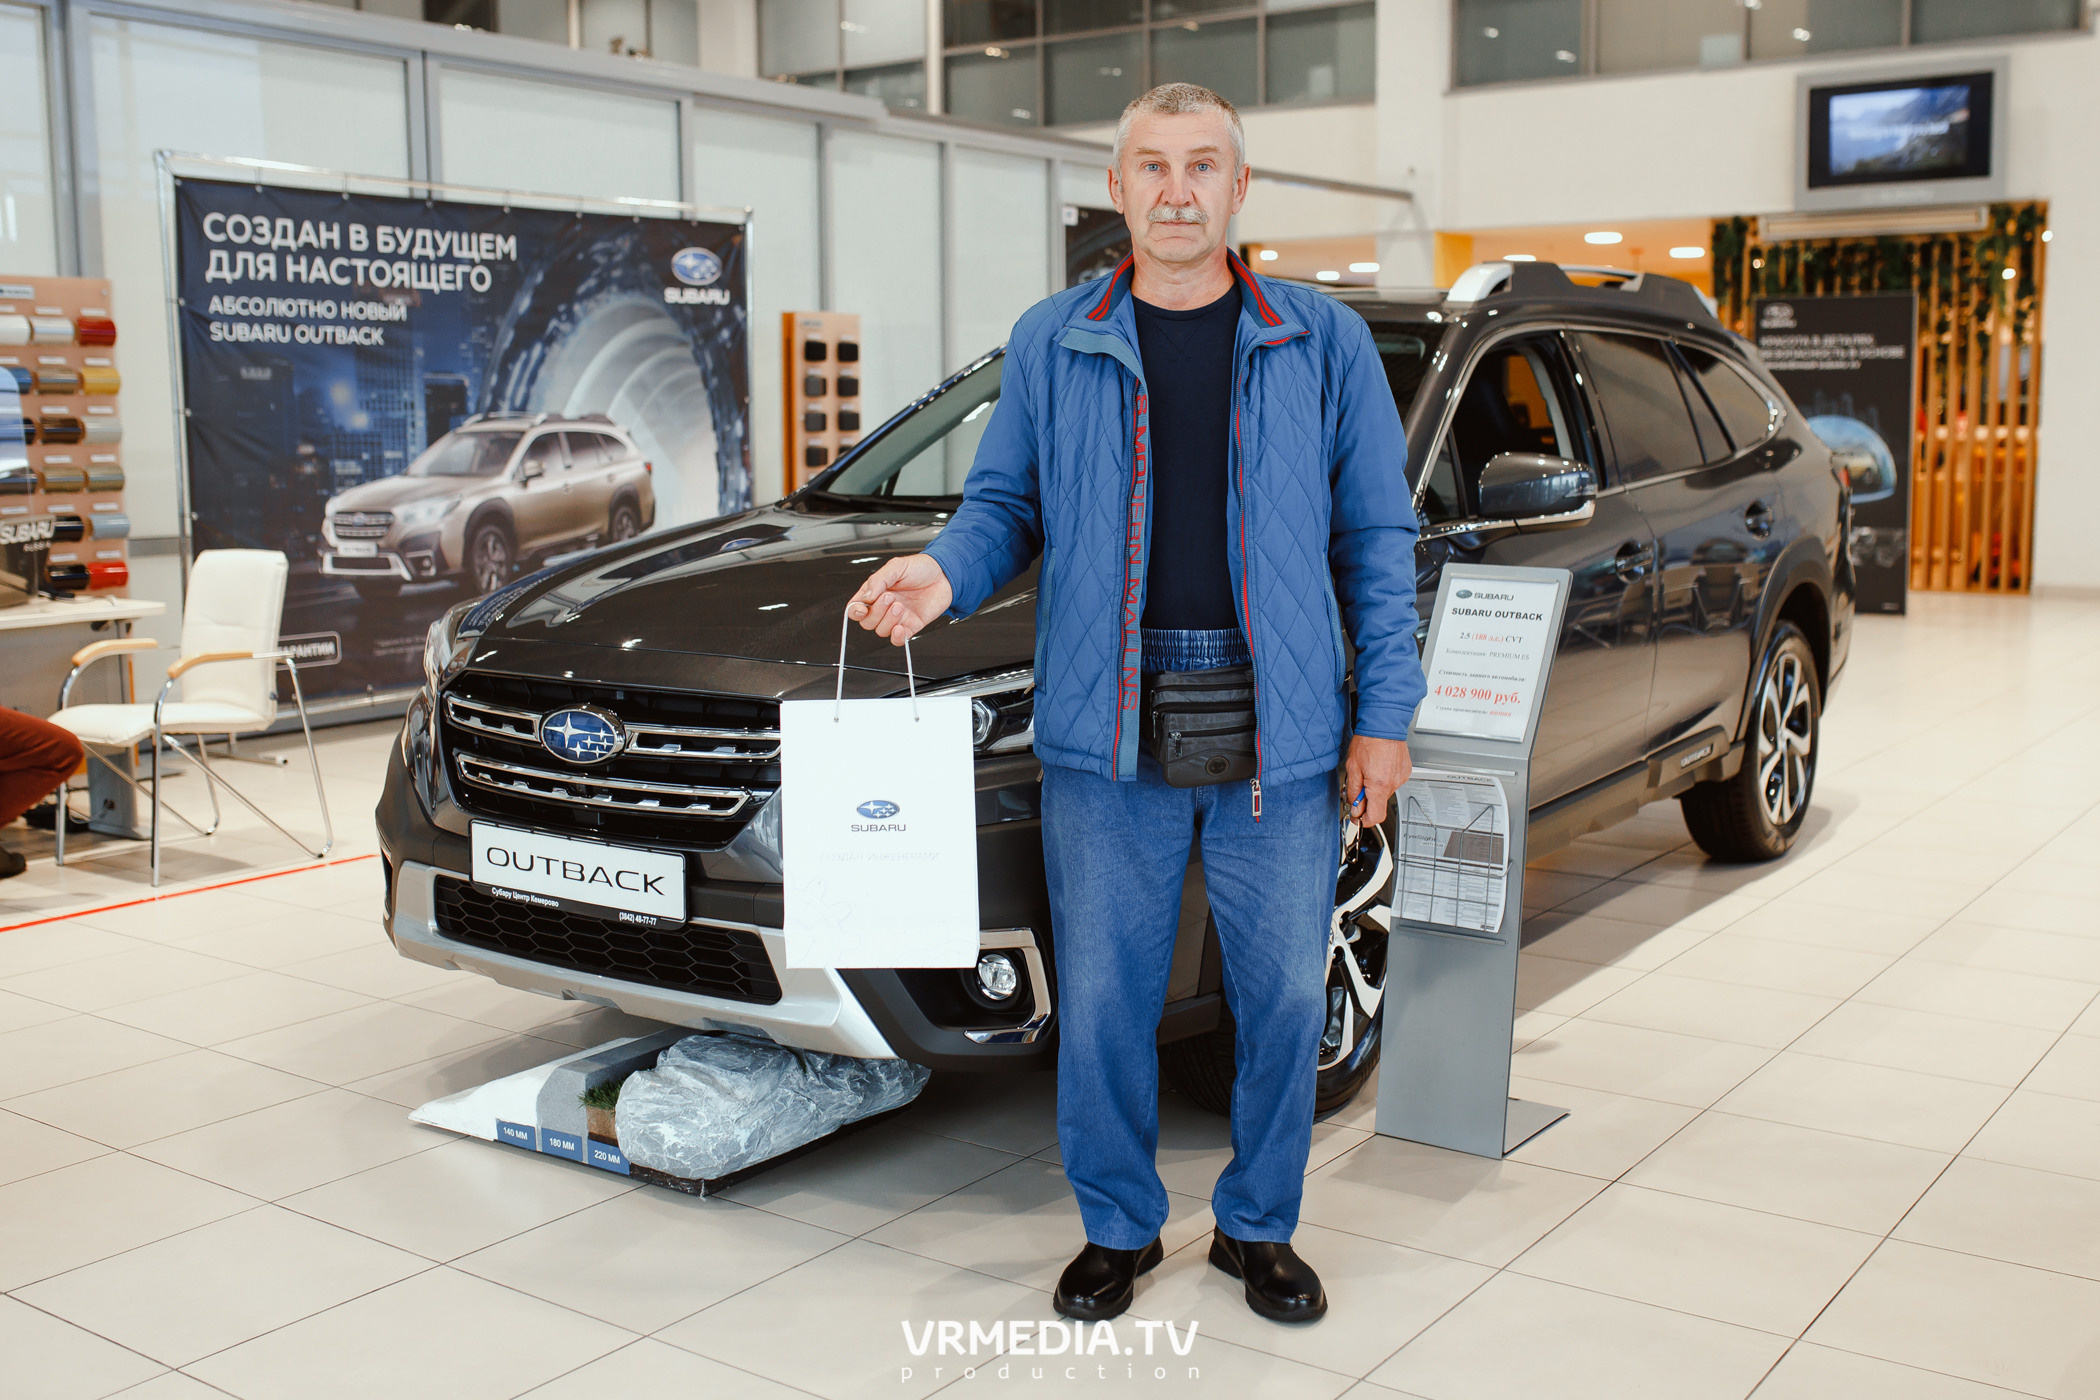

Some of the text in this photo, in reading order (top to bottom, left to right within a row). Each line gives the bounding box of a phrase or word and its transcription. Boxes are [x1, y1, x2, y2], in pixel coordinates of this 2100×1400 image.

[203, 212, 518, 264] СОЗДАН В БУДУЩЕМ
[205, 249, 493, 295] ДЛЯ НАСТОЯЩЕГО
[664, 287, 731, 305] SUBARU
[208, 295, 408, 322] АБСОЛЮТНО НОВЫЙ
[209, 321, 385, 346] SUBARU OUTBACK
[1474, 592, 1515, 601] SUBARU
[1451, 607, 1543, 621] SUBARU OUTBACK
[1460, 632, 1471, 640] 2.5
[1471, 632, 1488, 641] (188
[1505, 635, 1523, 644] CVT
[1439, 669, 1468, 677] Стоимость
[1434, 685, 1521, 705] 4 028 900 руб.
[851, 823, 906, 833] SUBARU
[486, 846, 666, 896] OUTBACK
[491, 887, 560, 908] Субару Центр Кемерово
[619, 911, 657, 926] (3842) 48-77-77
[503, 1126, 515, 1137] 140
[549, 1137, 562, 1149] 180
[594, 1149, 607, 1161] 220
